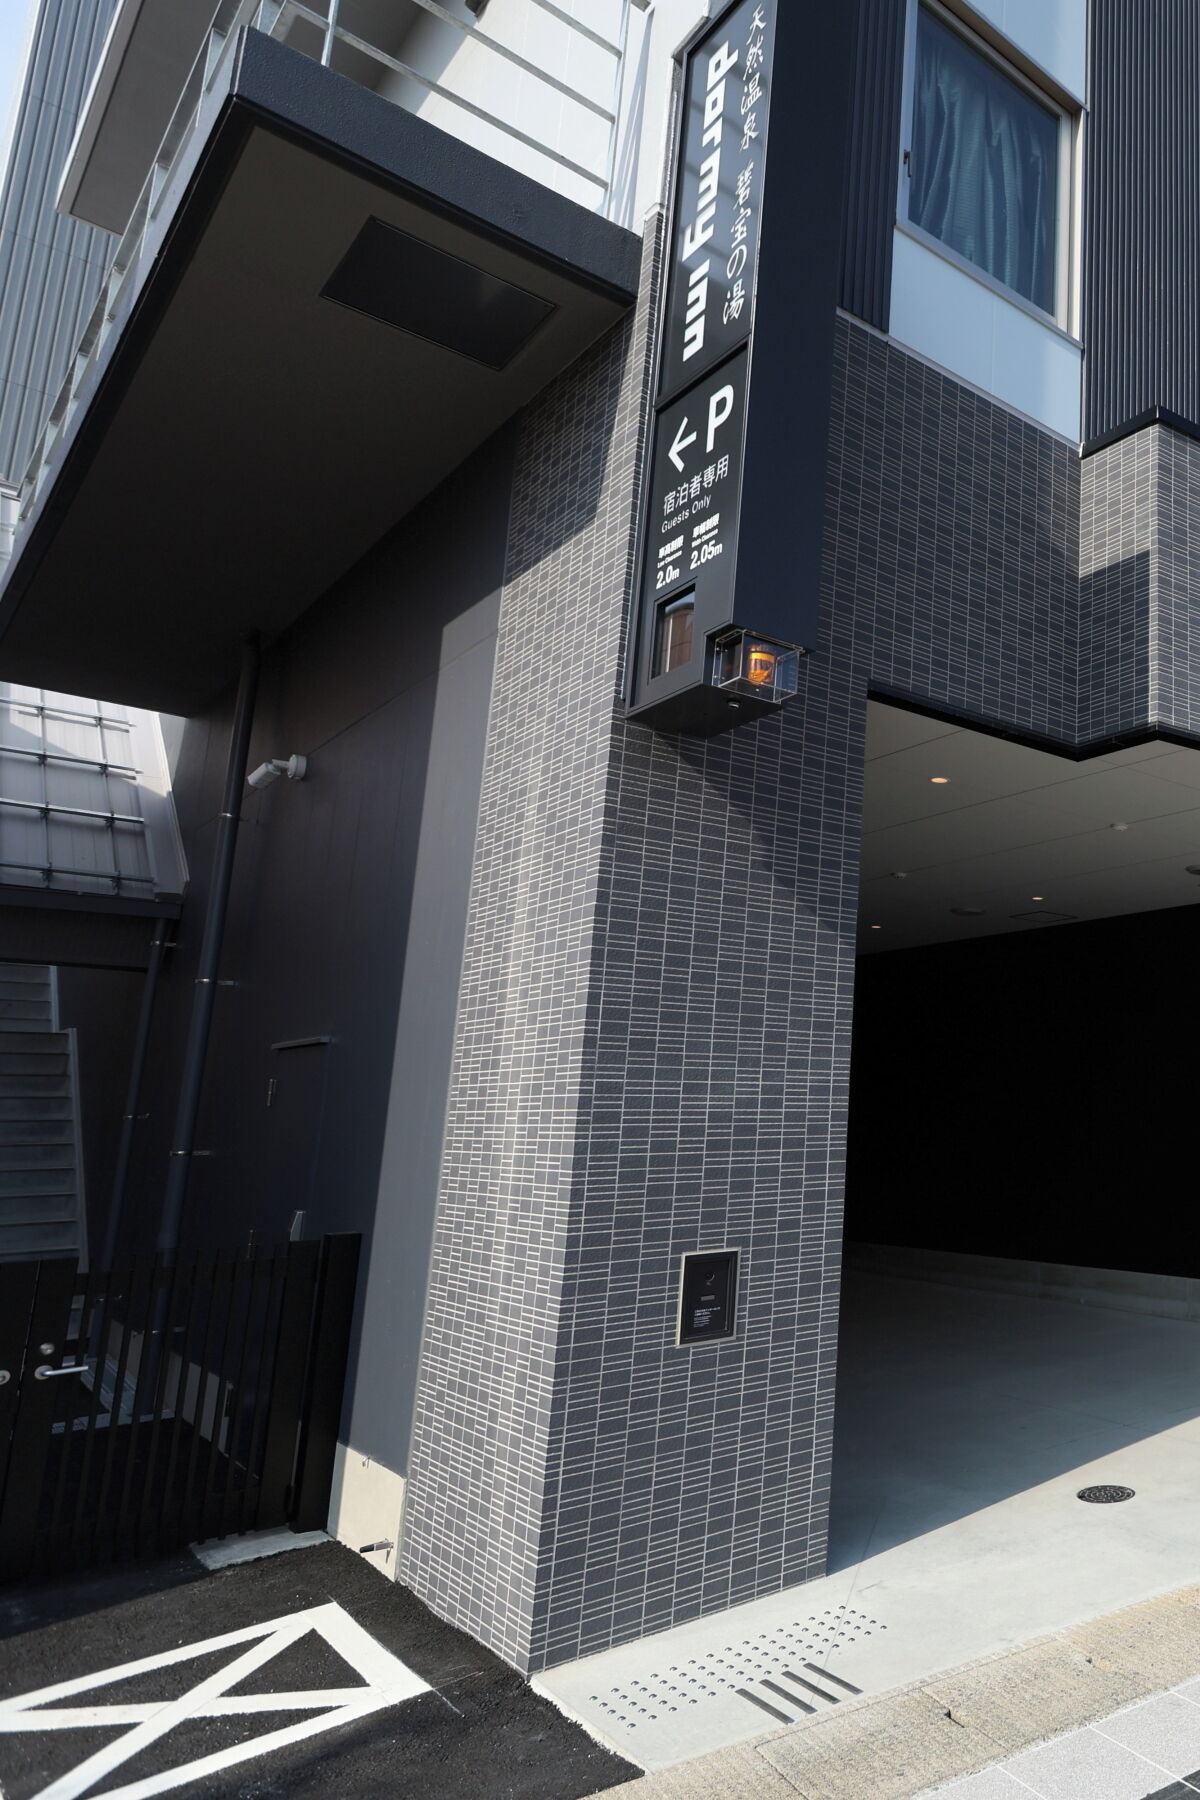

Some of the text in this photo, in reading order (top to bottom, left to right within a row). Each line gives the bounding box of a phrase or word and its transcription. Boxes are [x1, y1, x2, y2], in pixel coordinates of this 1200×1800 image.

[738, 2, 768, 153] 天然温泉
[681, 40, 740, 363] dormy inn
[706, 384, 735, 454] P
[661, 495, 712, 534] Guests Only
[663, 454, 730, 517] 宿泊者専用
[655, 565, 680, 590] 2.0m
[689, 540, 723, 570] 2.05m
